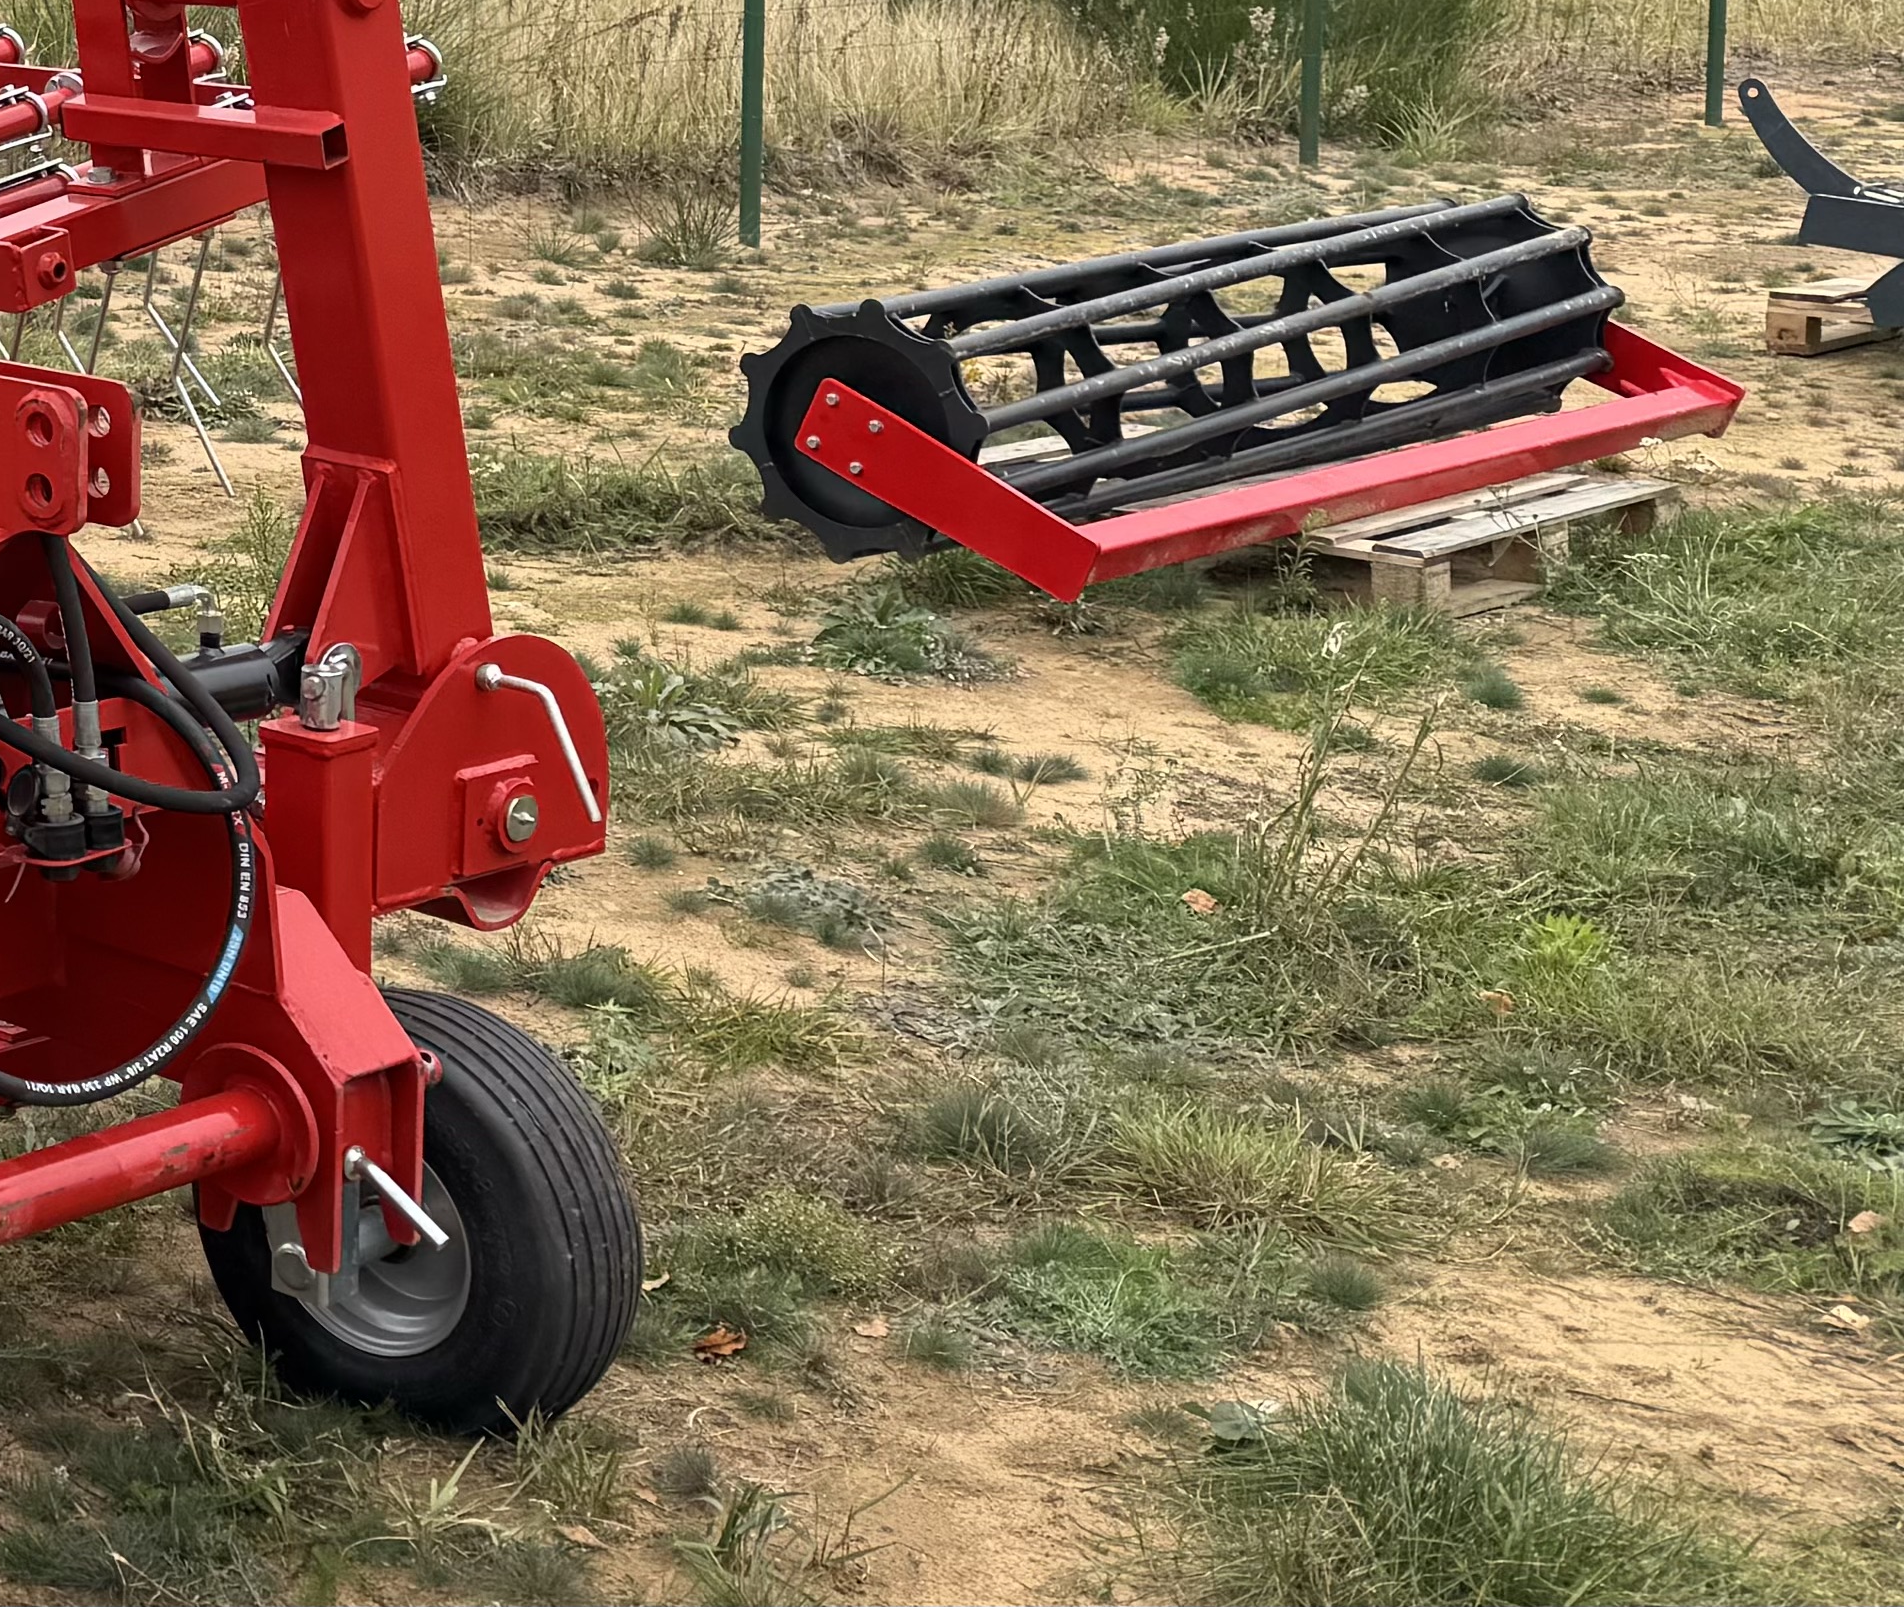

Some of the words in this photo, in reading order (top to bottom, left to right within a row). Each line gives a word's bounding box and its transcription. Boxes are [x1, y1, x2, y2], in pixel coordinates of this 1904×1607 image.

[238, 842, 251, 868] DIN
[240, 871, 252, 892] EN
[236, 894, 251, 920] 853
[185, 1001, 208, 1028] SAE
[169, 1025, 190, 1046] 100
[143, 1041, 174, 1068] R2AT
[103, 1072, 124, 1089] WP
